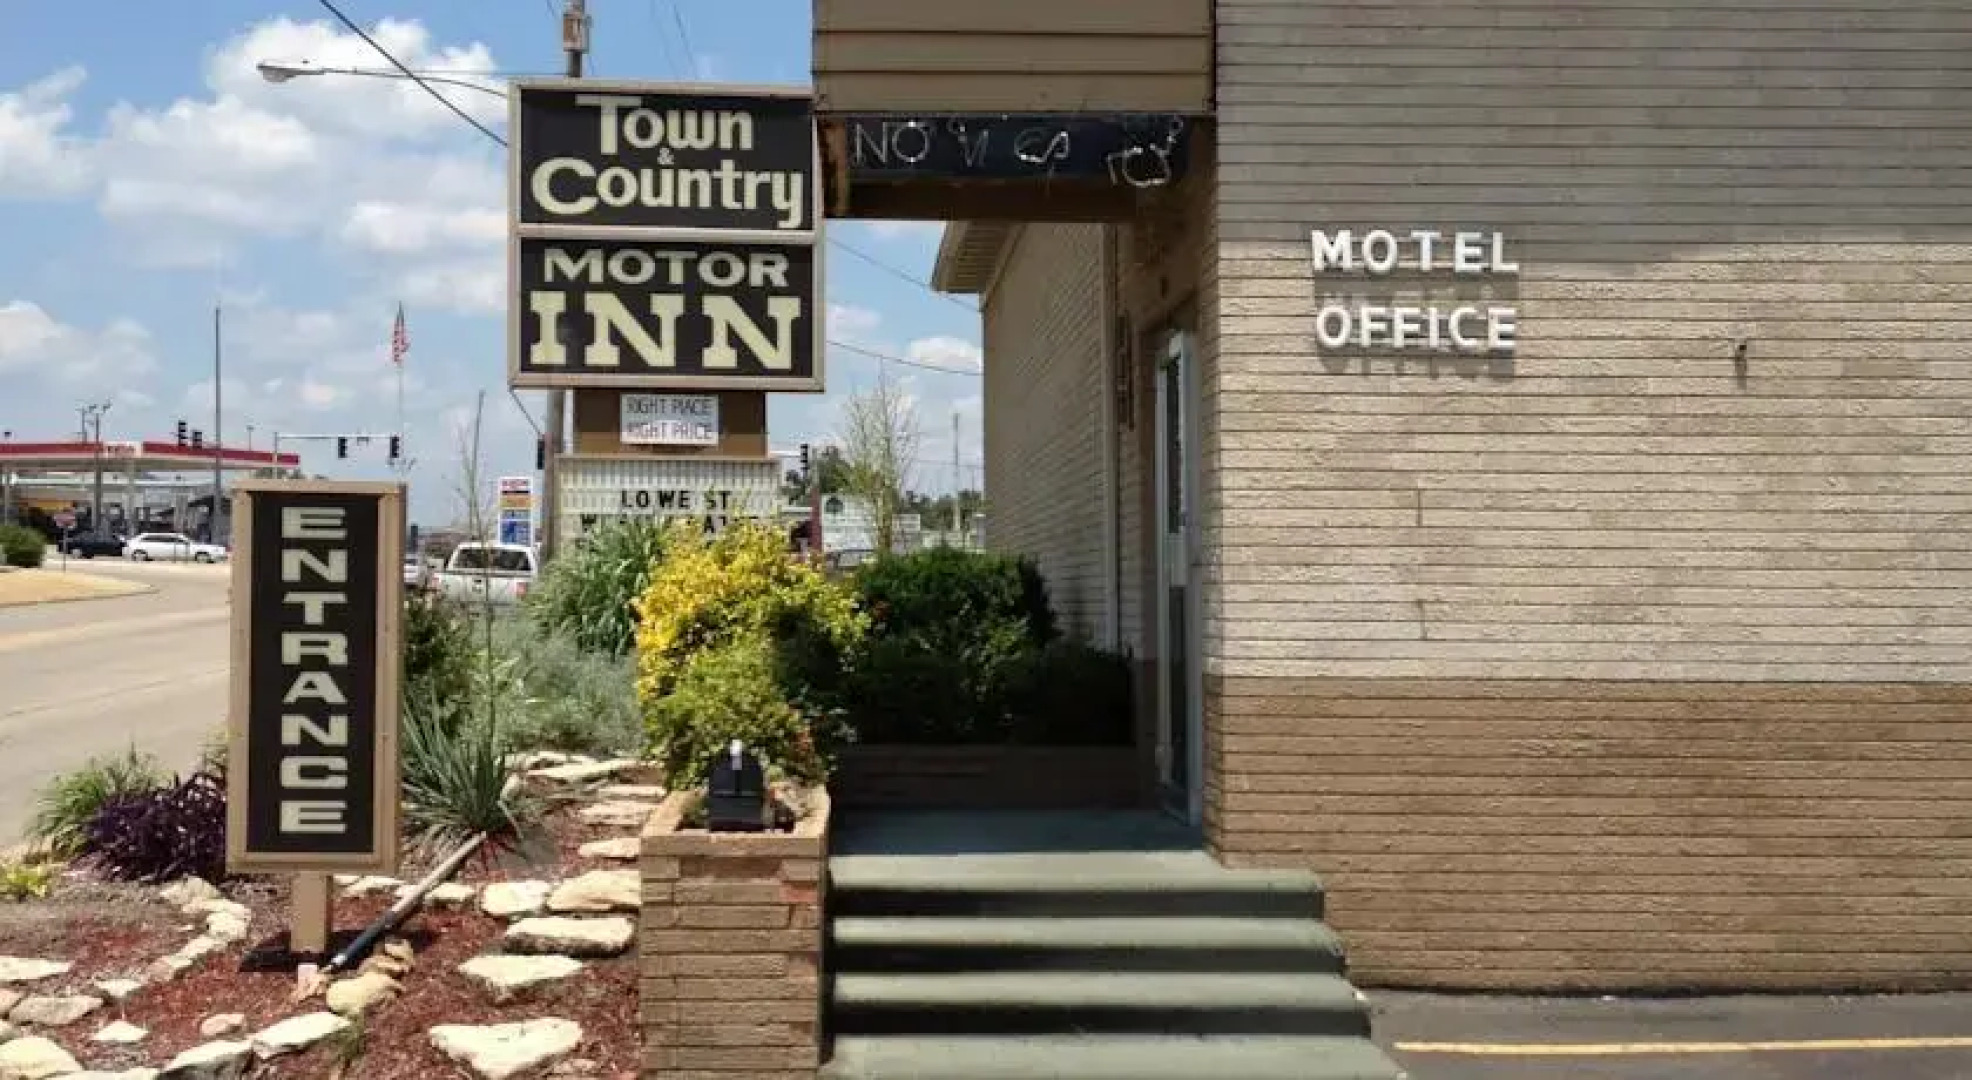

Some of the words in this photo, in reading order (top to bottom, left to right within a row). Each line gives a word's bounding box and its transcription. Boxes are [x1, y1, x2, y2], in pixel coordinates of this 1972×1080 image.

[575, 94, 752, 155] Town
[657, 147, 674, 165] &
[531, 156, 803, 229] Country
[544, 248, 789, 287] MOTOR
[1311, 229, 1519, 273] MOTEL
[530, 290, 801, 370] INN
[1317, 306, 1516, 348] OFFICE
[280, 506, 348, 834] ENTRANCE
